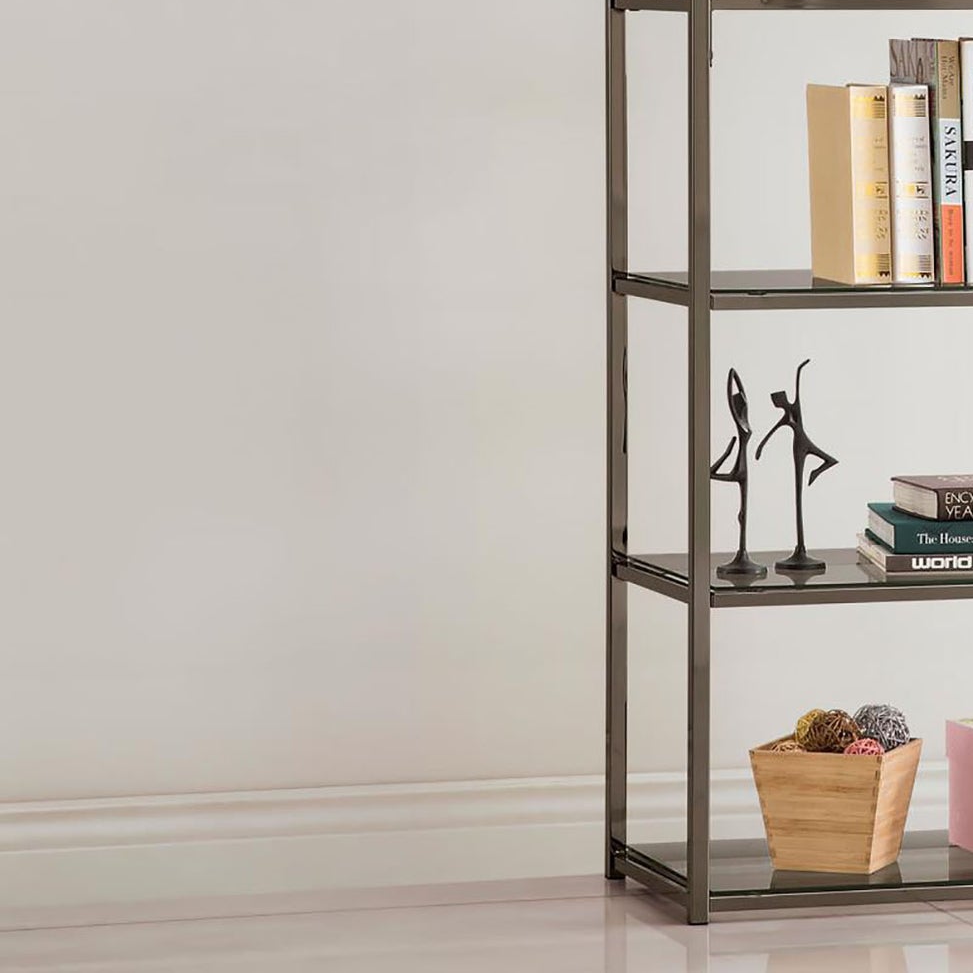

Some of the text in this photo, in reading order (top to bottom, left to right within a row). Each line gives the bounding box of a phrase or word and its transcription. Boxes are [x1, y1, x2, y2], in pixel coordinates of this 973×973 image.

[944, 126, 957, 197] SAKURA
[917, 533, 937, 545] The
[911, 555, 972, 570] world
